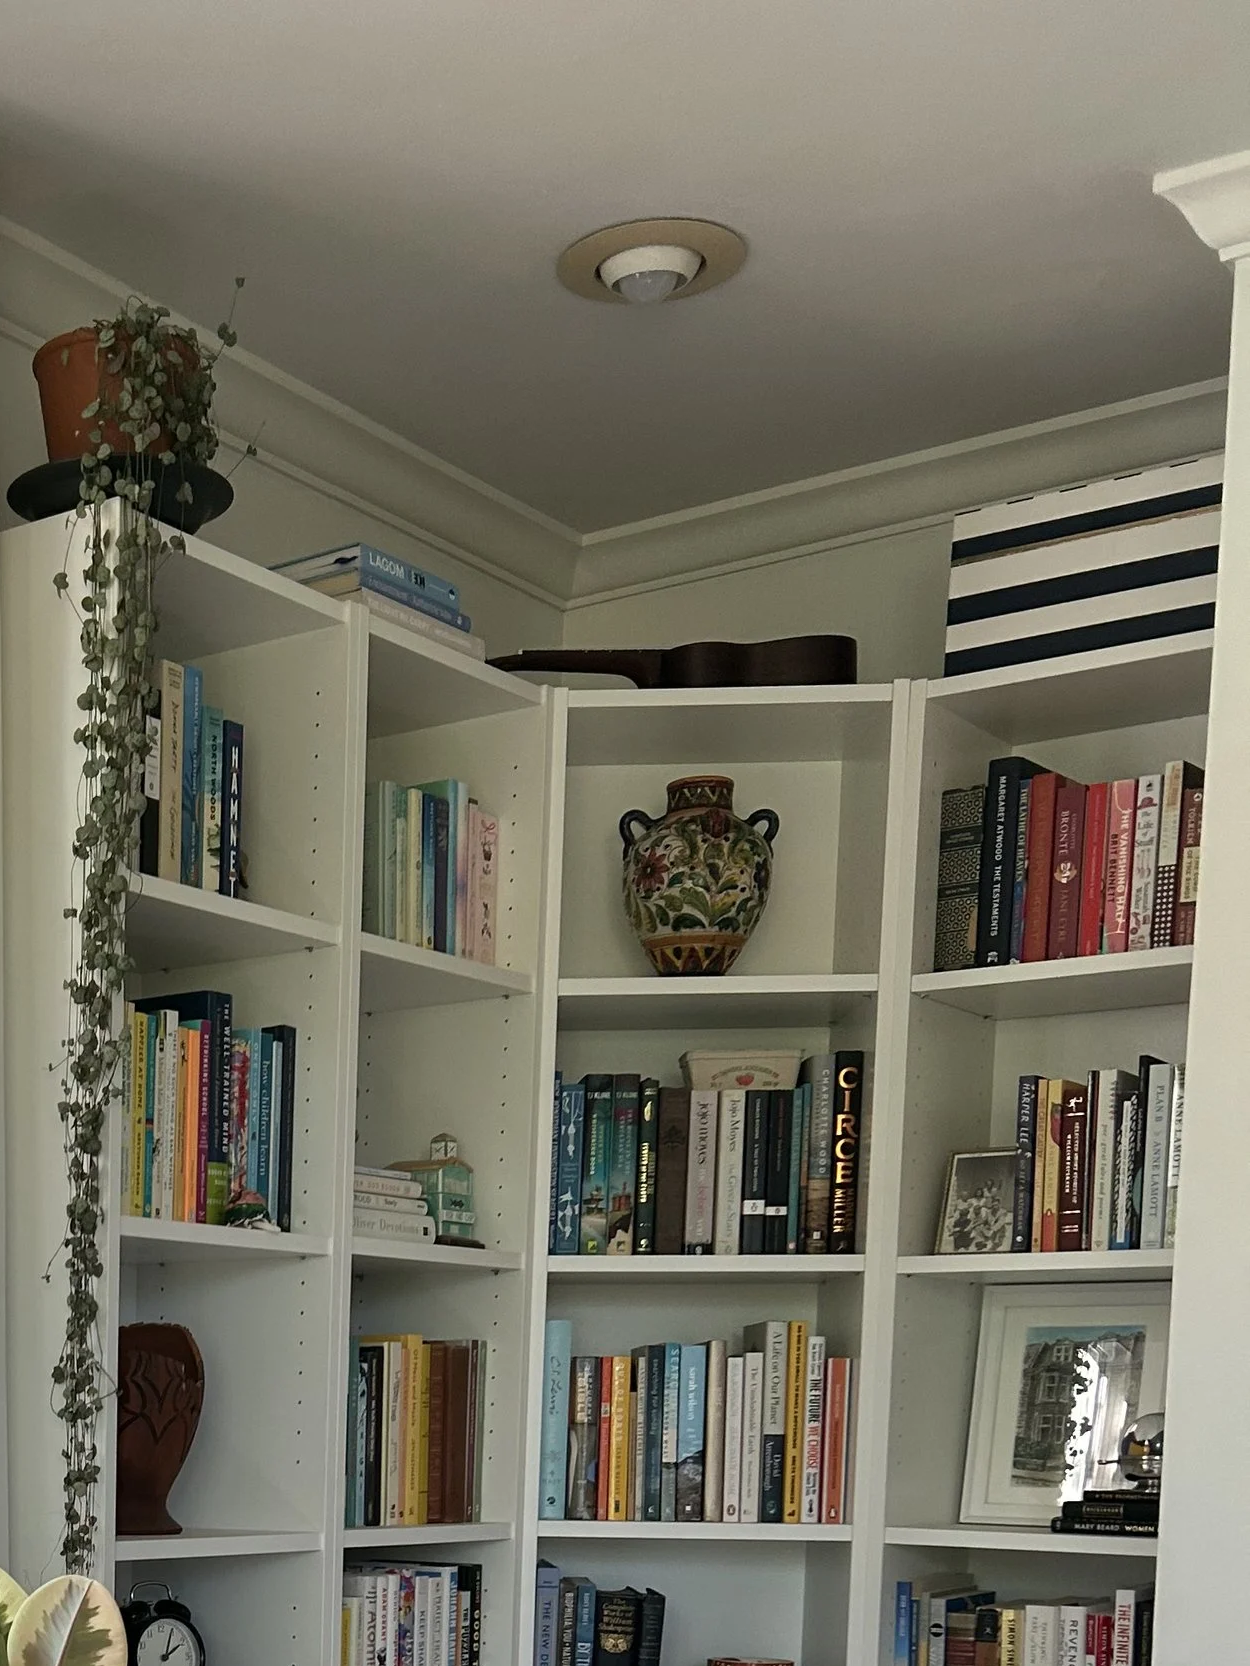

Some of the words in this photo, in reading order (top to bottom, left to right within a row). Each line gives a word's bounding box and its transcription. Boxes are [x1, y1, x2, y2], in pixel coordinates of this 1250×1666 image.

[369, 552, 405, 579] LAGOM
[210, 735, 218, 775] NORTH
[209, 778, 218, 821] WOODS
[996, 775, 1008, 822] MARGARET
[1020, 788, 1029, 805] THE
[229, 746, 239, 898] HAMNET
[1018, 806, 1028, 832] LATHE
[1119, 811, 1129, 831] THE
[994, 824, 1005, 861] ATWOOD
[1017, 835, 1026, 846] OF
[1109, 833, 1119, 856] BRIT
[993, 865, 1003, 881] THE
[1015, 848, 1027, 883] HEAVEN
[1116, 832, 1129, 894] VANISHING
[1106, 859, 1117, 903] BENNETT
[990, 883, 1002, 937] TESTAMENTS
[1114, 896, 1126, 924] HALF
[137, 1066, 144, 1080] AT
[201, 1034, 209, 1083] RETHINKING
[221, 1025, 231, 1117] WELL-TRAINED
[260, 1060, 269, 1086] how
[200, 1086, 208, 1117] SCHOOL
[820, 1069, 830, 1136] CHARLOTTE
[1020, 1083, 1031, 1121] HARPER
[1155, 1084, 1166, 1113] PLAN
[1175, 1094, 1185, 1127] ANNE
[260, 1088, 269, 1141] children
[835, 1067, 858, 1184] CIRCE
[221, 1121, 230, 1154] MIND
[1019, 1127, 1028, 1143] LEE
[259, 1143, 268, 1176] learn
[817, 1141, 827, 1174] WOOD
[1150, 1140, 1162, 1171] ANNE
[1171, 1129, 1182, 1178] LAMOTT
[832, 1188, 846, 1233] MILLER
[1149, 1174, 1161, 1218] LAMOTT
[770, 1341, 781, 1360] Life
[772, 1331, 781, 1340] A
[769, 1361, 777, 1373] on
[769, 1375, 781, 1394] Our
[809, 1378, 823, 1393] THE
[768, 1396, 780, 1425] Planet
[807, 1394, 822, 1424] FUTURE
[807, 1425, 819, 1438] WE
[805, 1439, 819, 1470] CHOOSE
[418, 1610, 426, 1635] KEEP
[543, 1599, 552, 1622] THE
[1118, 1604, 1130, 1622] THE
[472, 1609, 480, 1652] GOOD
[541, 1625, 550, 1648] NEW
[1006, 1619, 1016, 1646] SIMON
[1115, 1624, 1129, 1666] INFINITE
[577, 1642, 591, 1655] BY
